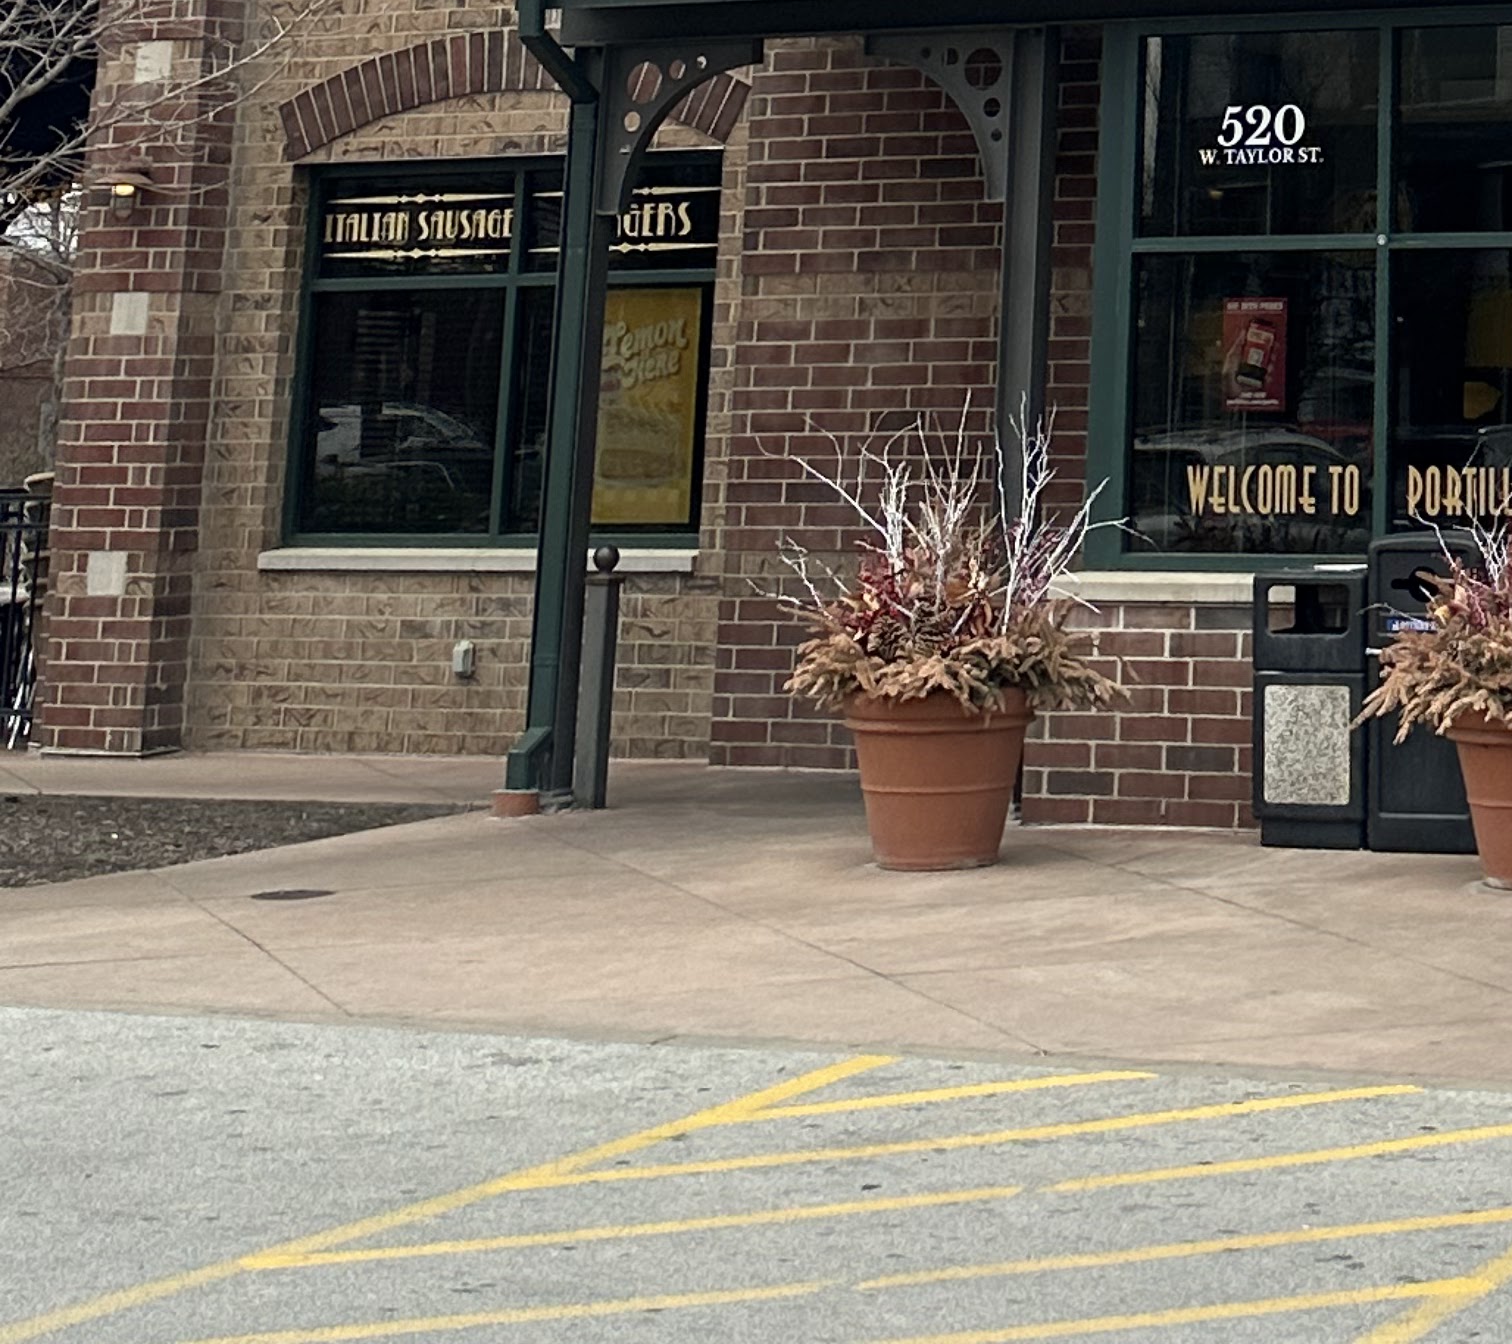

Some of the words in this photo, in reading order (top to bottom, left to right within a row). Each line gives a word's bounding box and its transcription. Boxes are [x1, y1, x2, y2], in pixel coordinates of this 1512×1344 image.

[1217, 103, 1306, 147] 520
[1198, 148, 1221, 166] W.
[1223, 147, 1295, 165] TAYLOR
[1297, 146, 1325, 164] ST.
[323, 210, 410, 243] ITALIAN
[418, 208, 514, 241] SAUSAGE
[615, 201, 693, 238] GERS
[1186, 463, 1318, 516] WELCOME
[1328, 463, 1360, 516] TO
